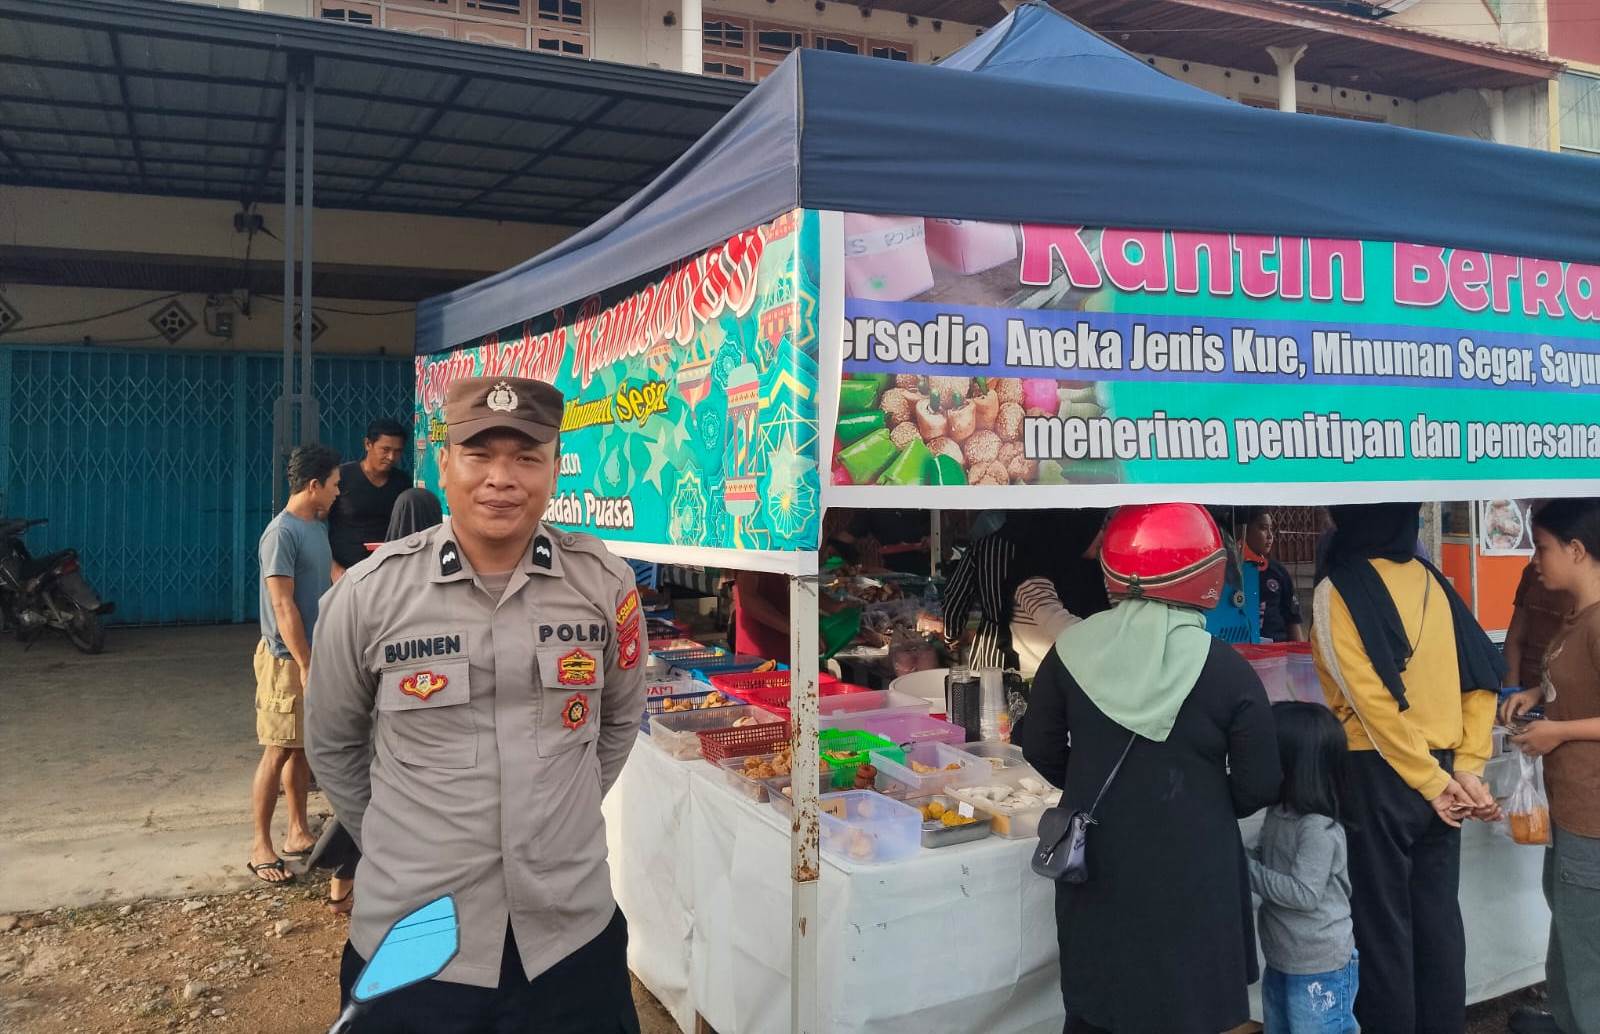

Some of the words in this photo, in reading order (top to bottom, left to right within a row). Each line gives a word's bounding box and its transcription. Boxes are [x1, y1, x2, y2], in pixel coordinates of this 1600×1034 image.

[1019, 221, 1365, 303] Kantin
[1004, 318, 1123, 371] Aneka
[1128, 324, 1226, 373] Jenis
[1231, 327, 1307, 380] Kue,
[1311, 330, 1453, 379] Minuman
[1457, 337, 1537, 387] Segar,
[1022, 410, 1229, 461] menerima
[1234, 411, 1406, 464] penitipan
[1409, 413, 1461, 460] dan
[583, 488, 635, 529] Puasa
[384, 635, 461, 663] BUINEN
[538, 623, 607, 643] POLRI
